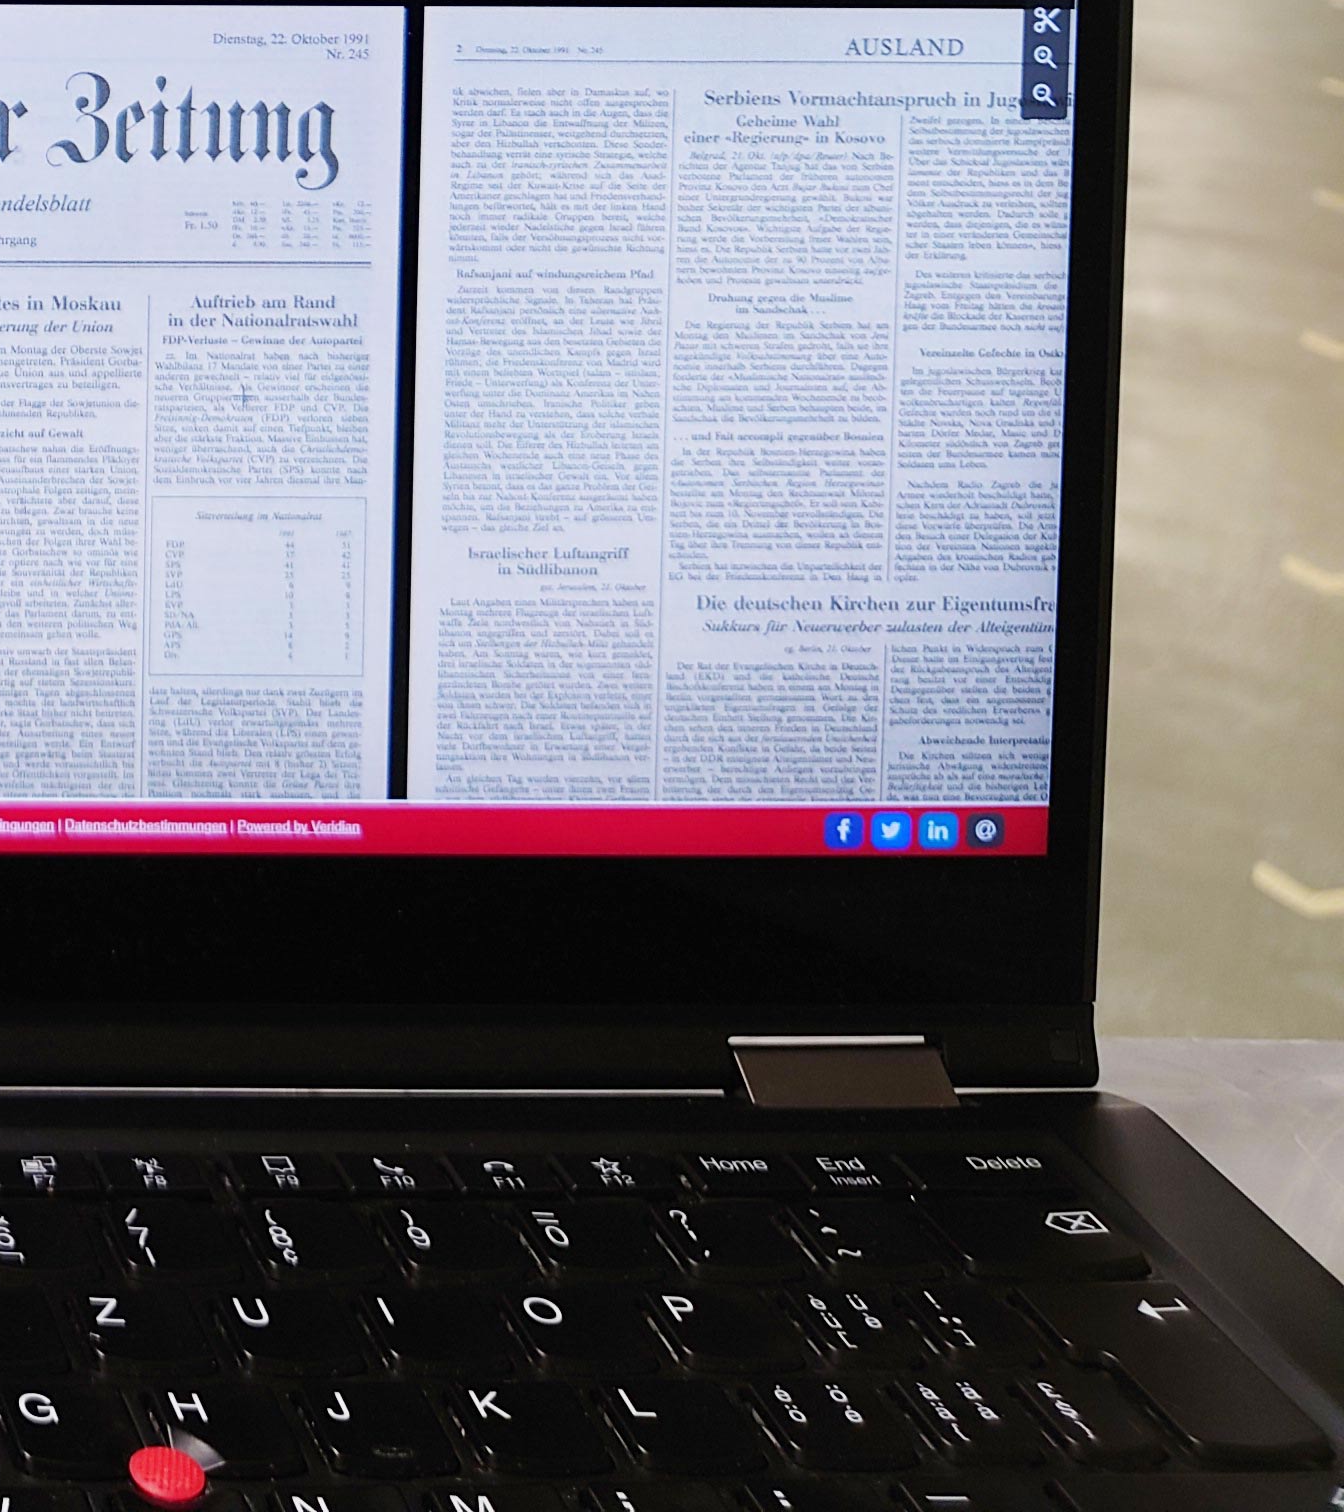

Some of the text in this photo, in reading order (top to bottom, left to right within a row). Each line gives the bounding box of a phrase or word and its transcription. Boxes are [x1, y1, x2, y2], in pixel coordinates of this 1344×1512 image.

[213, 33, 267, 47] Dienstag,
[292, 33, 339, 44] Oktober
[344, 34, 368, 44] 1991
[845, 38, 963, 56] AUSLAND
[327, 49, 369, 59] Nr. 245
[704, 90, 781, 105] Serbiens
[788, 90, 956, 111] Vormachtanspruch
[964, 92, 980, 106] in
[736, 115, 839, 128] Geheime Wahl
[46, 72, 339, 190] Zeitung
[684, 131, 720, 143] einer
[816, 132, 828, 143] in
[835, 131, 885, 144] Kosovo
[28, 296, 43, 310] in
[52, 296, 120, 311] Moskau
[192, 295, 335, 309] Auftrieb am Rand
[169, 313, 357, 327] in der Nationalratswahl
[469, 547, 629, 562] Israelischer Luftangriff
[497, 563, 511, 575] in
[698, 596, 725, 610] Die
[734, 596, 822, 610] deutschen
[831, 596, 899, 611] Kirchen
[907, 601, 935, 611] zur
[64, 817, 227, 833] Datenschutzbestimmungen
[237, 819, 361, 835] Powered by Veridian
[699, 1157, 767, 1171] Home
[816, 1157, 865, 1171] End
[966, 1156, 1041, 1169] Delete
[830, 1175, 881, 1185] Insert
[89, 1297, 125, 1326] Z
[233, 1298, 269, 1326] U
[377, 1298, 394, 1324] I
[523, 1297, 562, 1324] O
[662, 1296, 693, 1321] P
[19, 1393, 59, 1423] G
[168, 1392, 208, 1422] H
[327, 1392, 350, 1420] J
[469, 1390, 511, 1419] K
[618, 1389, 657, 1417] L
